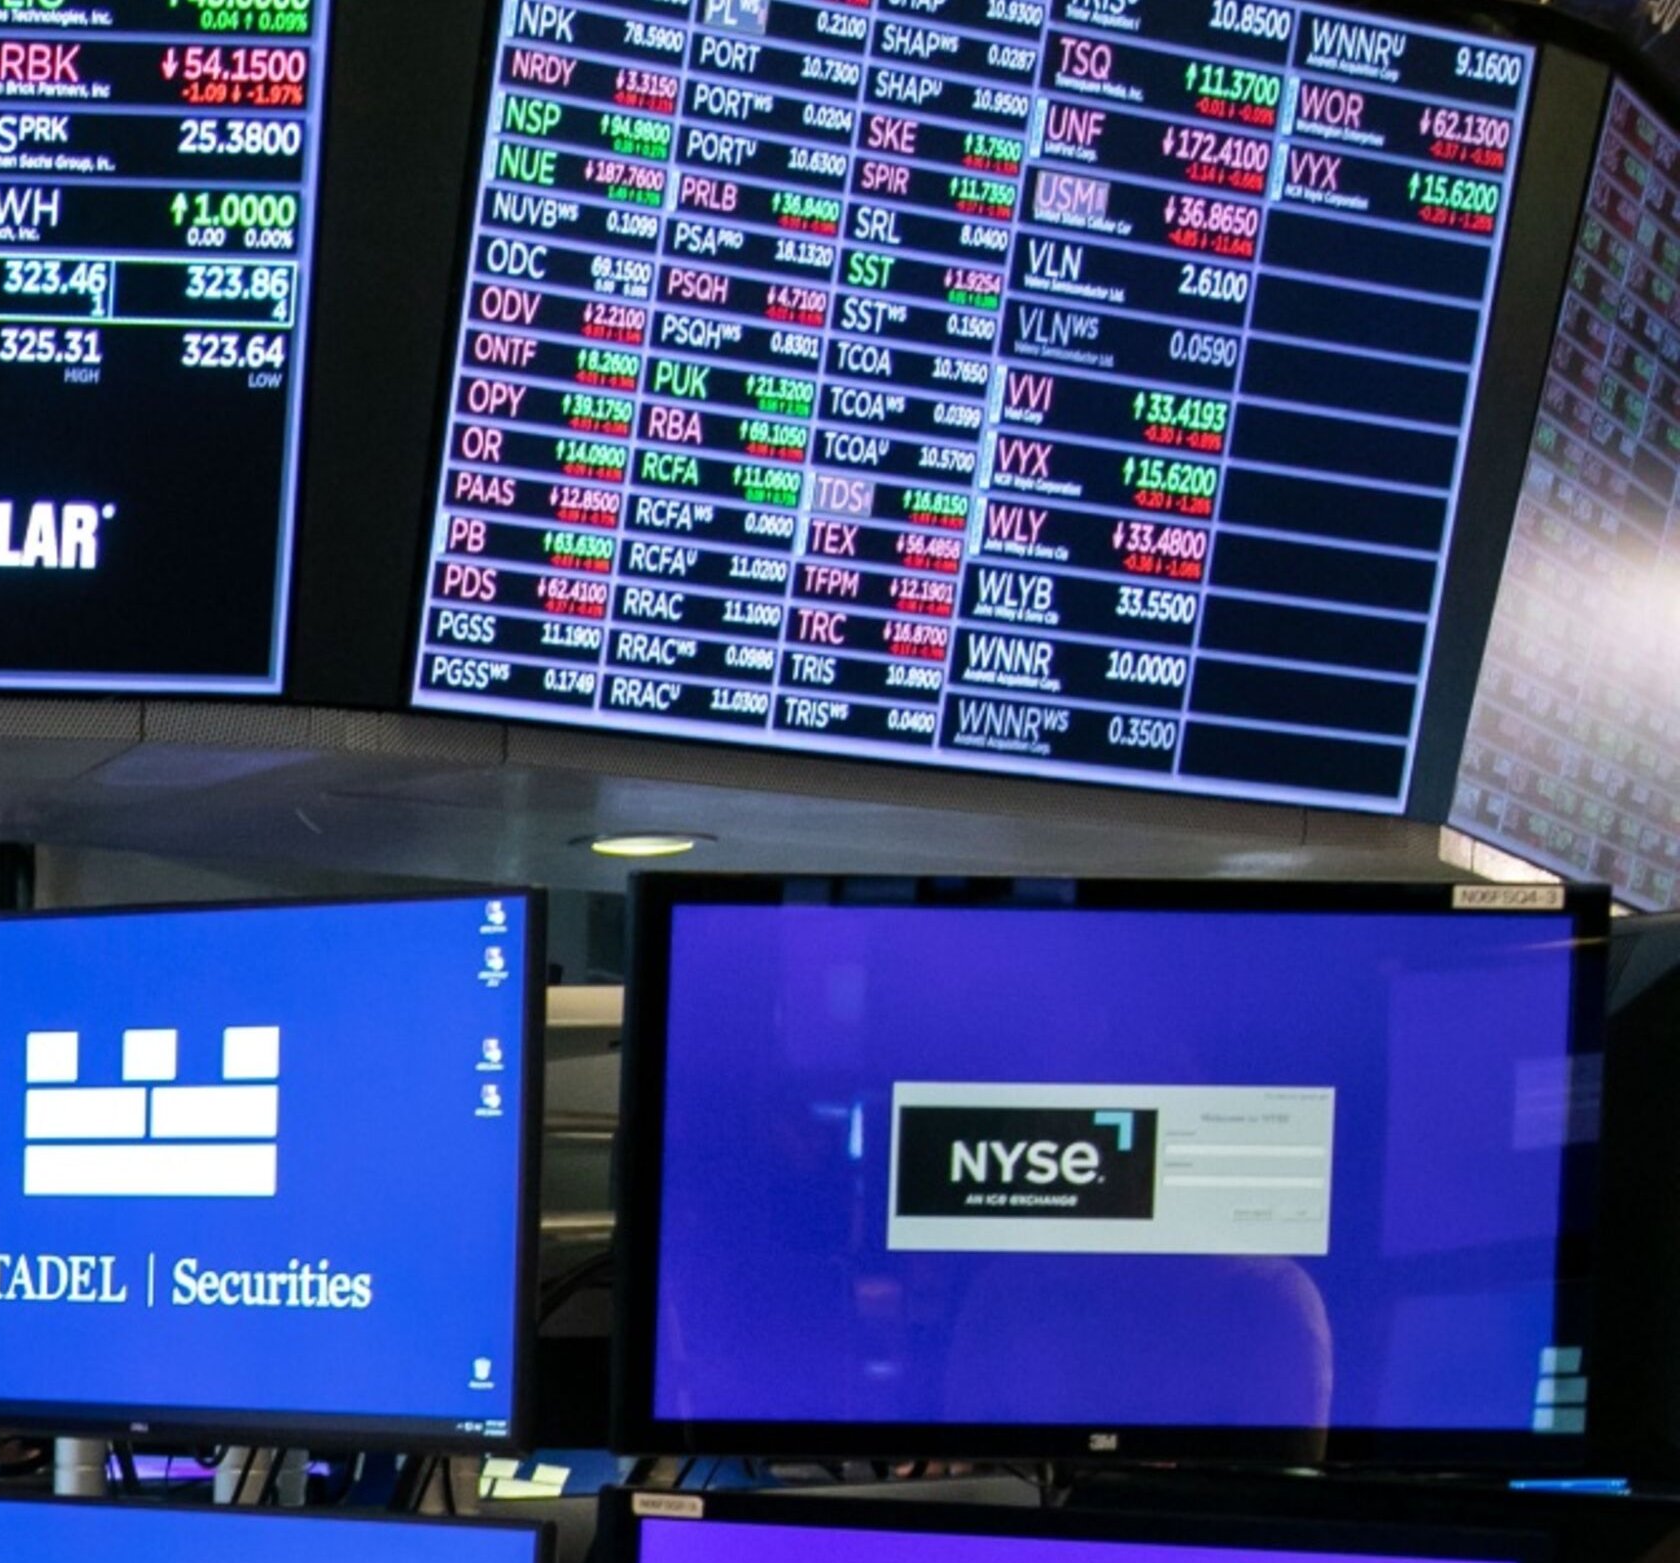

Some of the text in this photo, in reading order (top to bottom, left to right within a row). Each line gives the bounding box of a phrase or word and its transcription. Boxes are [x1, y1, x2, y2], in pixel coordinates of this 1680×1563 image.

[184, 49, 305, 82] 54.1500
[700, 38, 760, 72] PORT
[1058, 38, 1279, 106] TSQ 11.3700
[506, 98, 561, 134] NSP
[1302, 86, 1509, 149] WOR 62.1300
[179, 121, 299, 155] 25.3800
[1049, 105, 1269, 170] UNF 172.4100
[488, 240, 546, 278] ODC
[1028, 241, 1248, 302] VLN 2.6100
[4, 261, 106, 295] 323.46
[186, 266, 288, 299] 323.86
[0, 330, 101, 362] 325.31
[182, 335, 284, 368] 323.64
[64, 368, 99, 384] HIGH
[248, 374, 281, 389] LOW
[656, 362, 708, 398] PUK
[998, 438, 1217, 497] VYX 15.6200
[812, 521, 857, 555] TEX
[978, 568, 1195, 624] WLYB 33.5500
[438, 612, 496, 642] PGSS
[967, 634, 1185, 688] WNNR 10.0000
[172, 1259, 372, 1309] Securities
[1089, 1434, 1117, 1450] 3M
